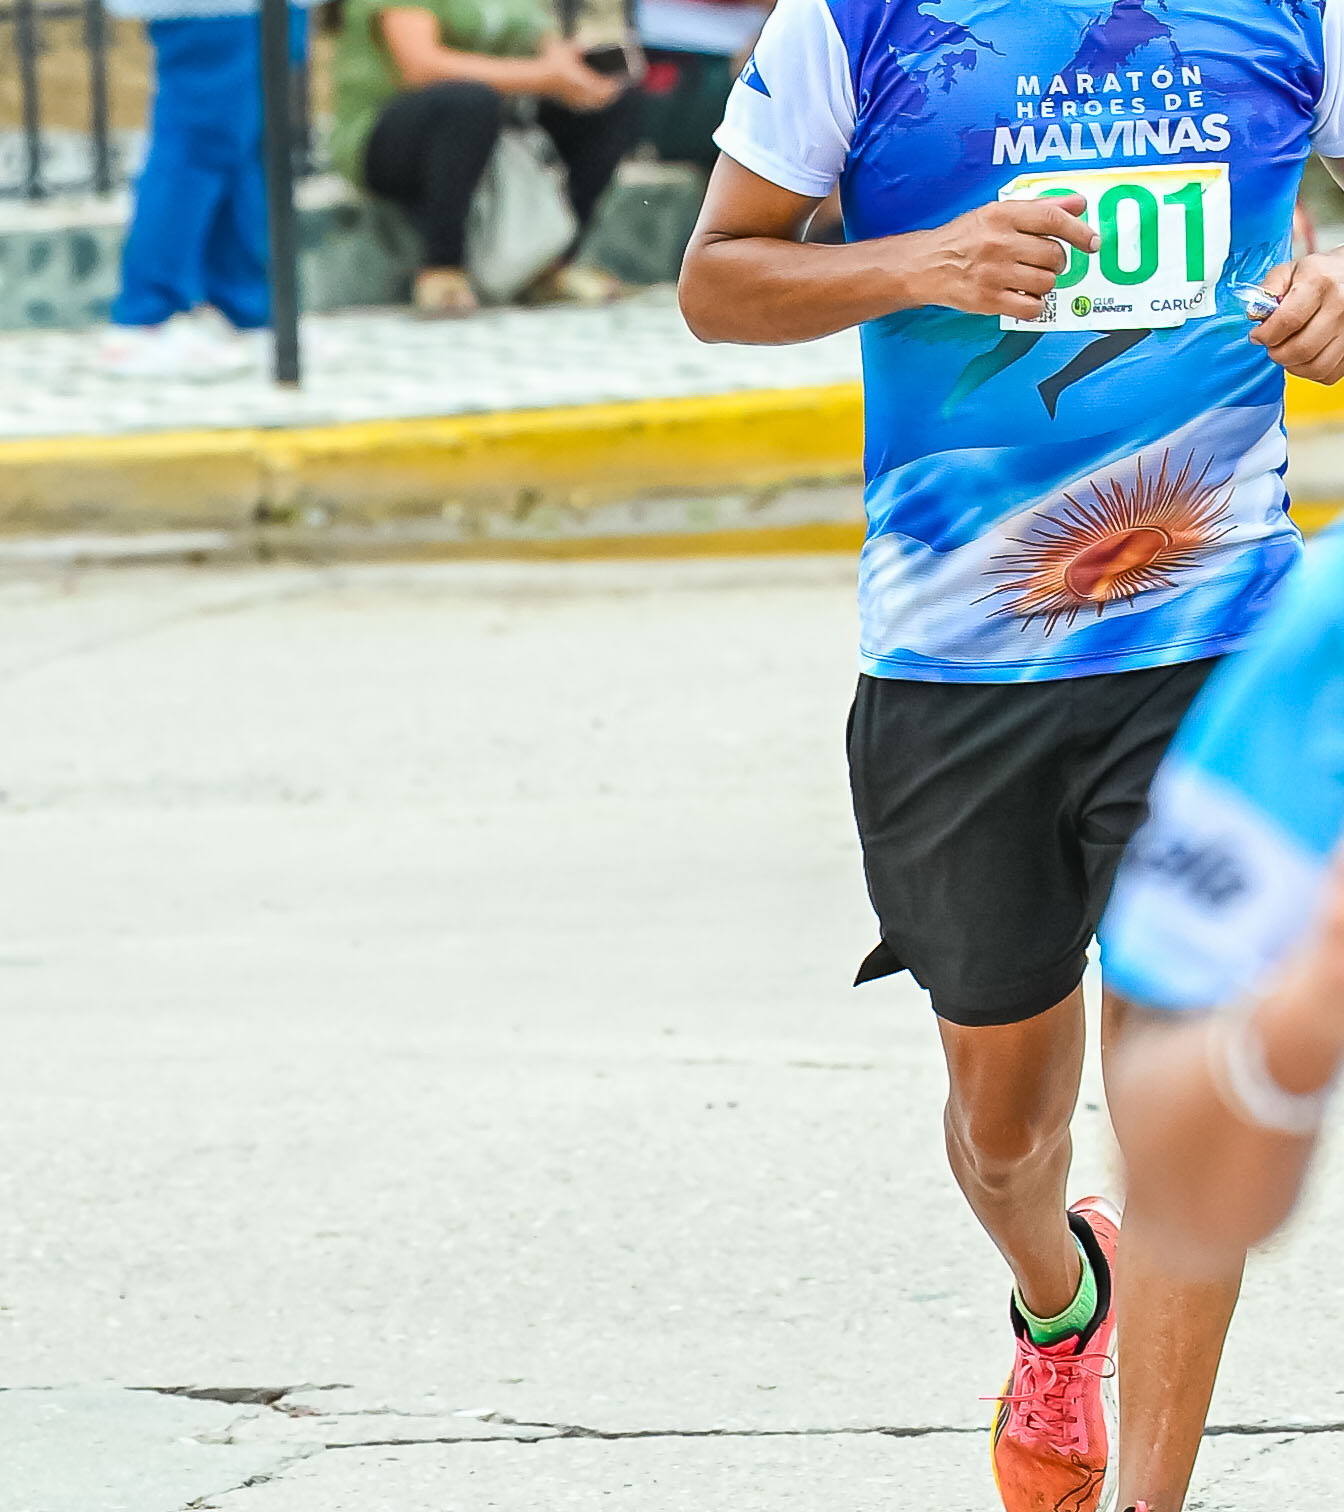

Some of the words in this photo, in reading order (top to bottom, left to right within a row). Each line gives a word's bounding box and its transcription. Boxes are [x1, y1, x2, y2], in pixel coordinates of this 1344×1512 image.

[1016, 65, 1202, 96] MARATÓN
[1016, 97, 1146, 119] HÉROES
[1164, 90, 1204, 111] DE
[992, 112, 1231, 165] MALVINAS
[1093, 297, 1115, 305] CLUB
